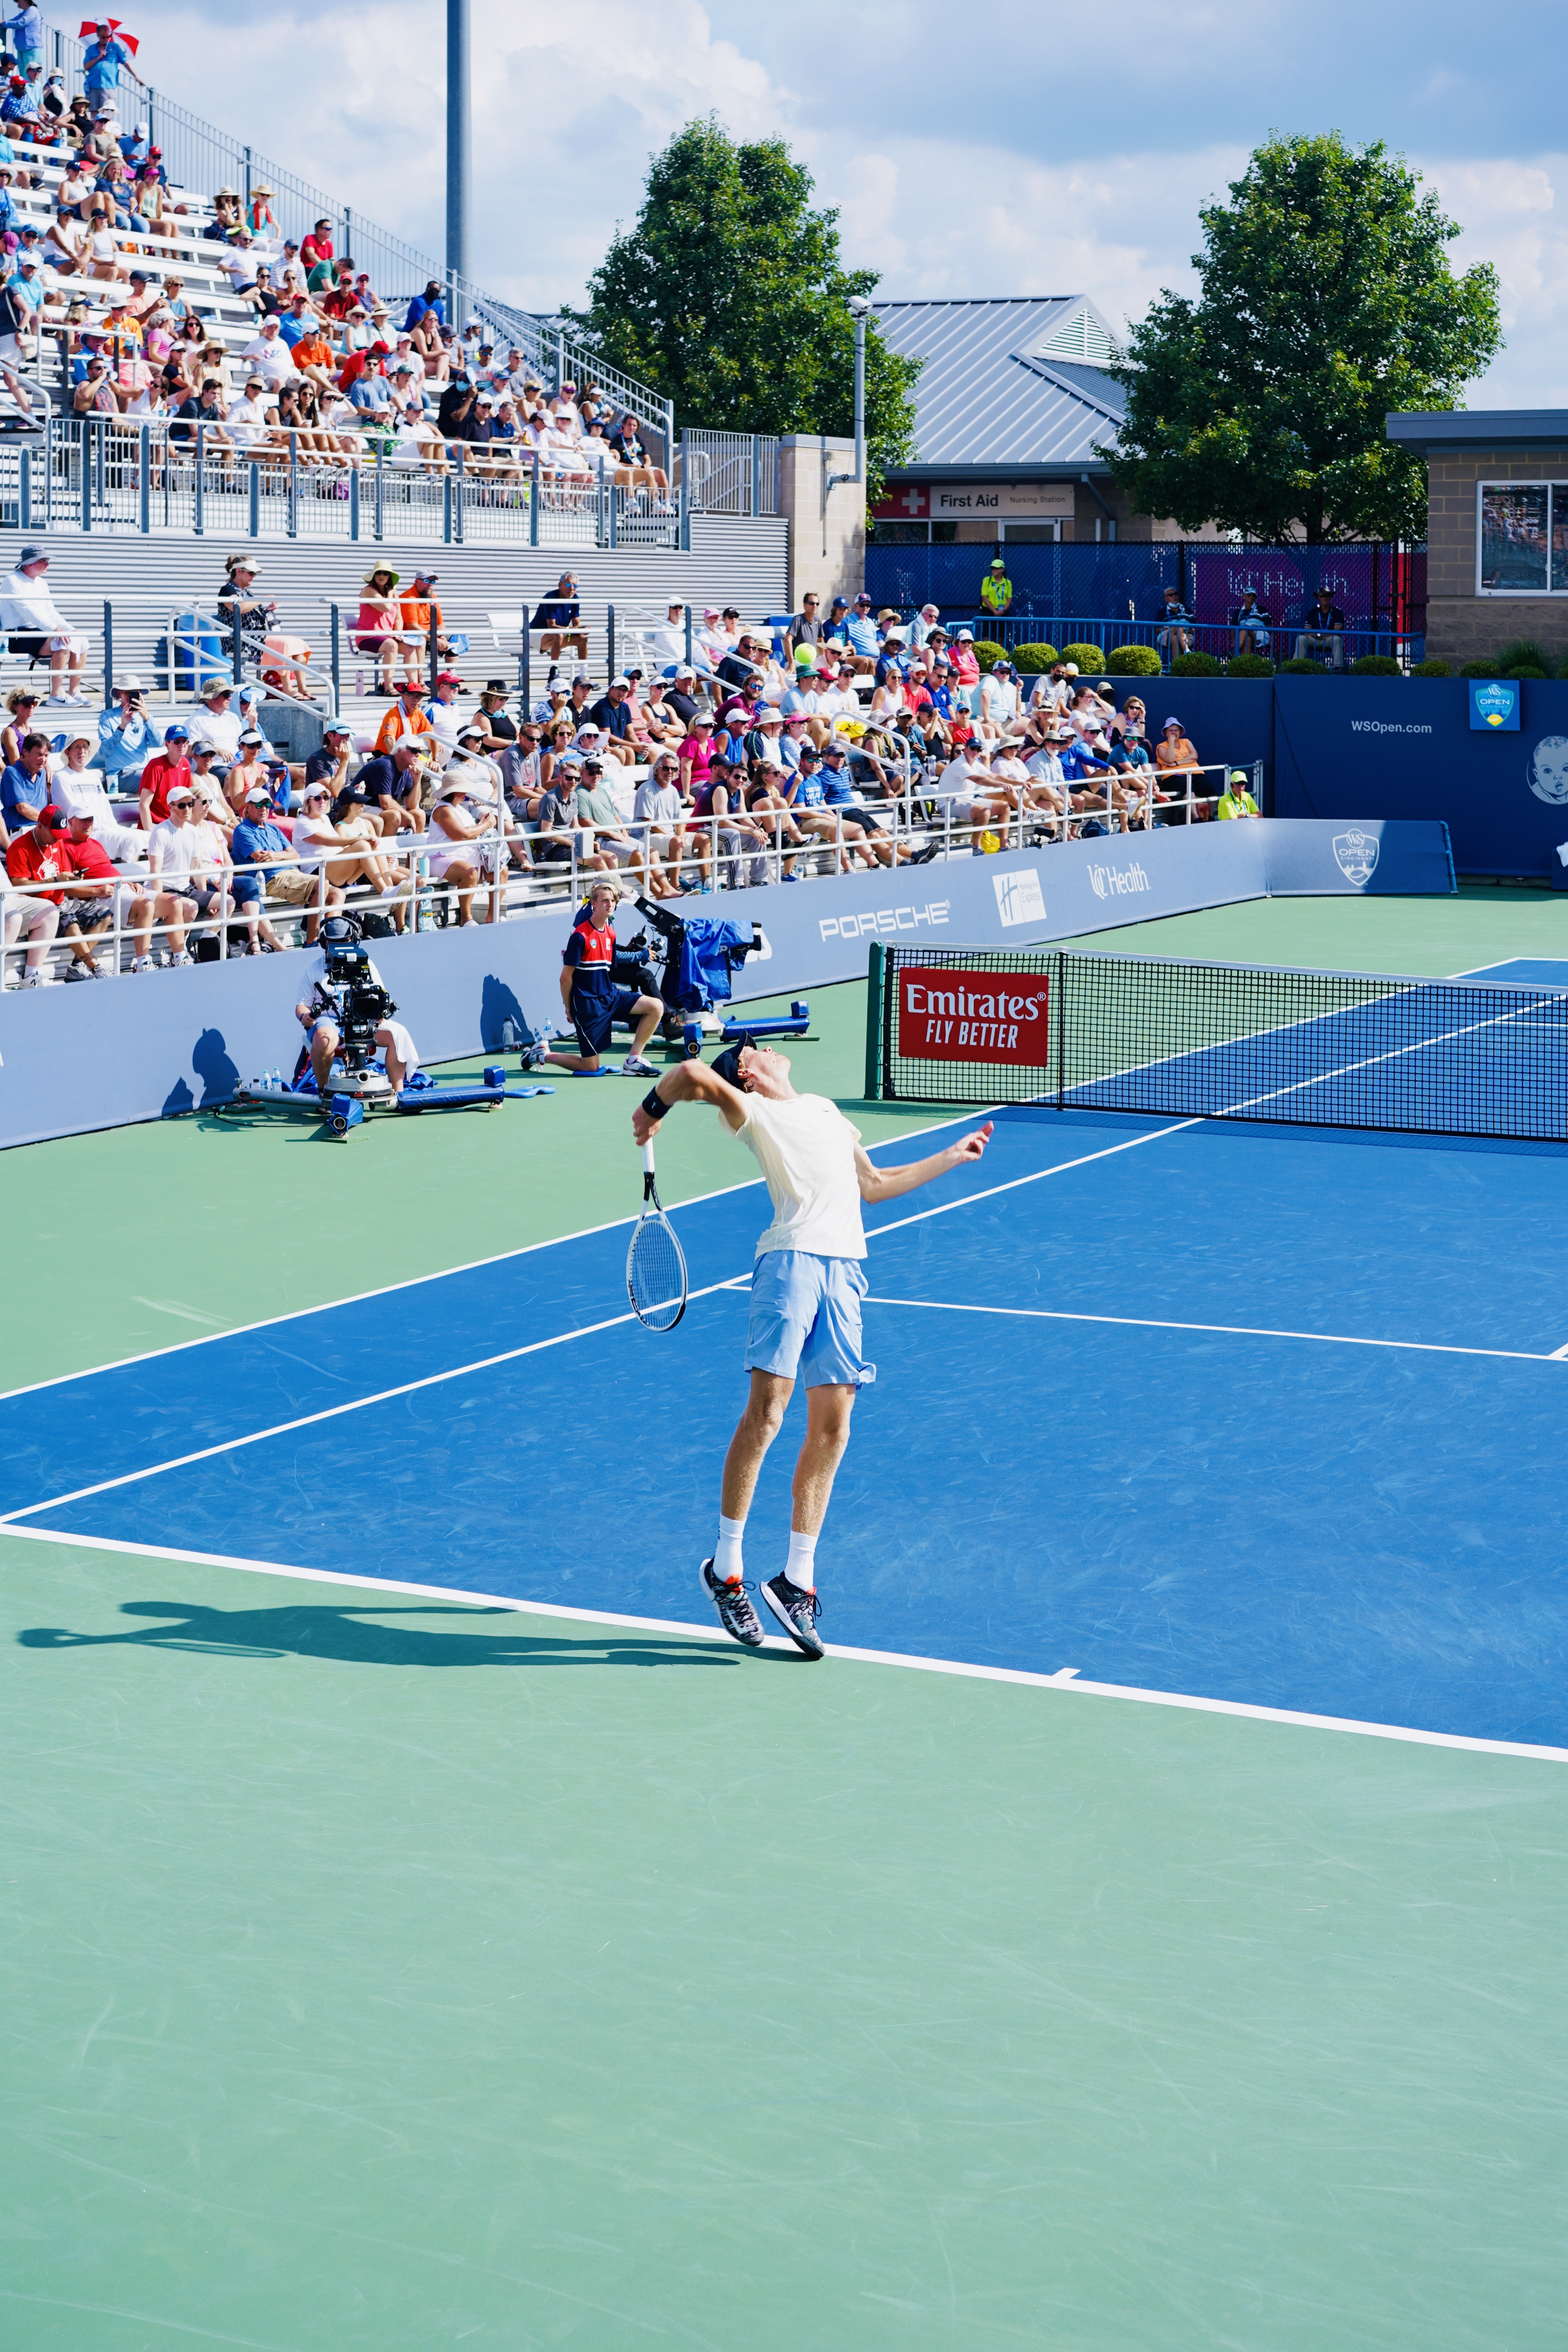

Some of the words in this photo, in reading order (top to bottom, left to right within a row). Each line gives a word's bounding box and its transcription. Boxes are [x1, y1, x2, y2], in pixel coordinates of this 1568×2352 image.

[940, 494, 971, 507] First
[975, 494, 998, 507] Aid
[1351, 720, 1432, 734] WSOpen.com
[1105, 862, 1150, 895] Health
[1019, 882, 1032, 890] Holiday
[1021, 892, 1041, 905] Express
[926, 1020, 953, 1044] FLY
[958, 1022, 1018, 1048] BETTER
